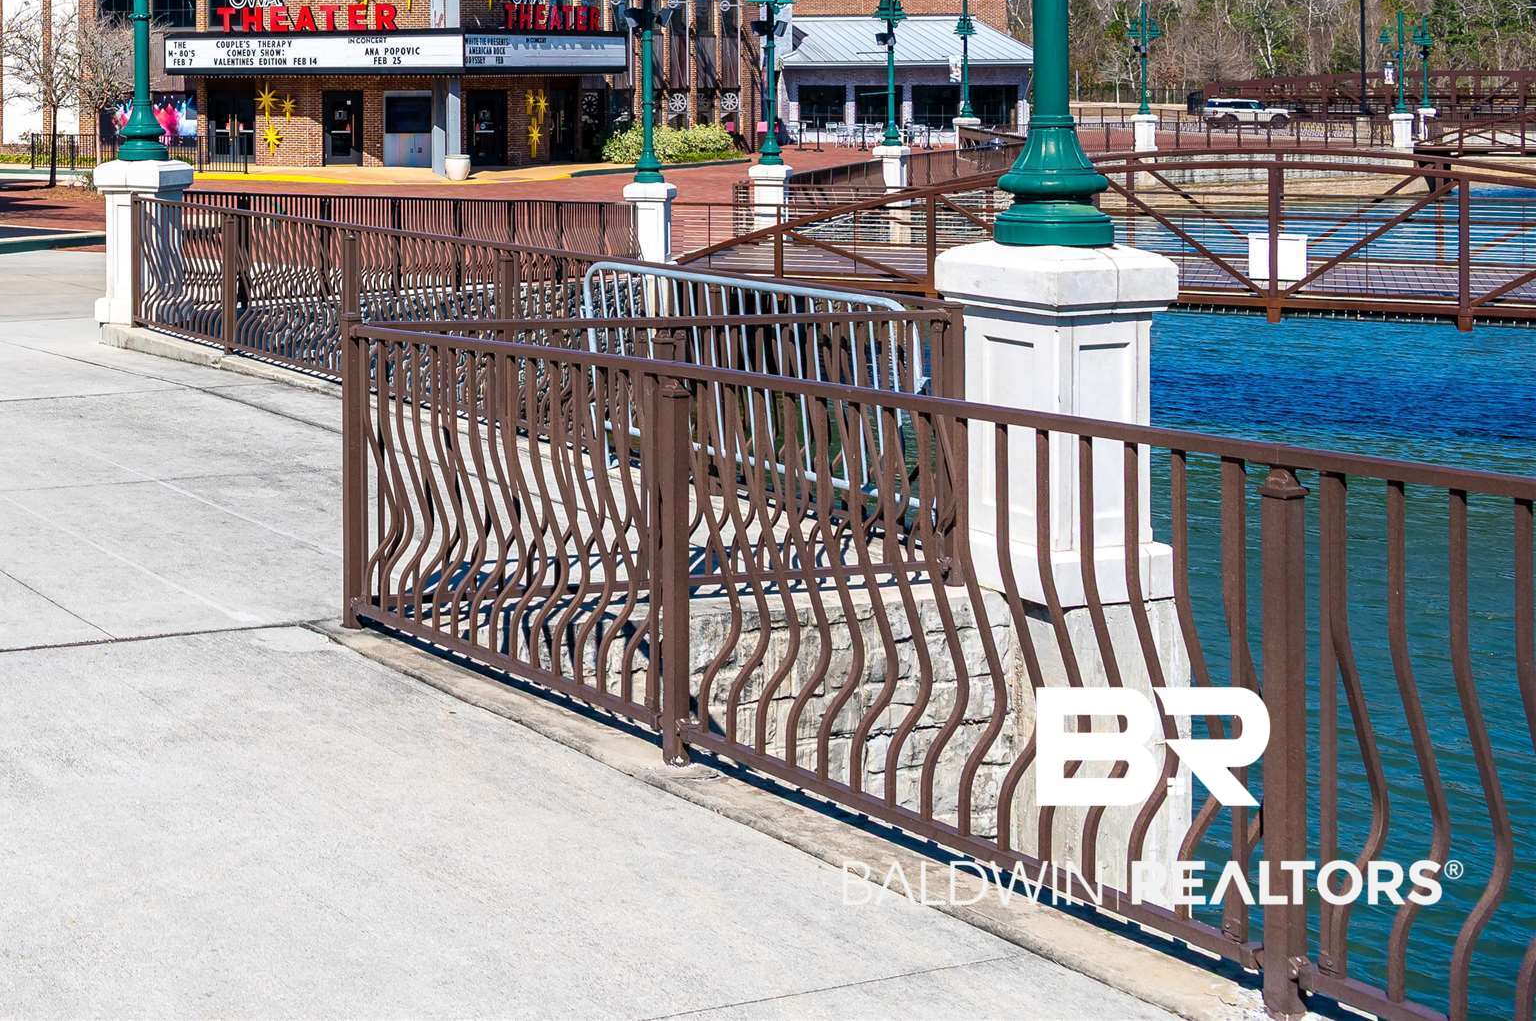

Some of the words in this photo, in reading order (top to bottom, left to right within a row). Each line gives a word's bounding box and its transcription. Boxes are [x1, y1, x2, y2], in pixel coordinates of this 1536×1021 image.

[217, 3, 397, 33] THEATER
[504, 4, 601, 31] THEATER
[216, 41, 250, 49] COUPLE'S
[227, 49, 256, 57] COMEDY
[260, 49, 285, 57] SHOW:
[364, 47, 379, 55] ANA
[384, 47, 420, 55] POPOVIC
[468, 47, 492, 55] AMERICAN
[493, 47, 506, 55] ROCK
[214, 58, 254, 66] VALENTINES
[373, 57, 387, 65] FEB
[392, 57, 402, 65] 25
